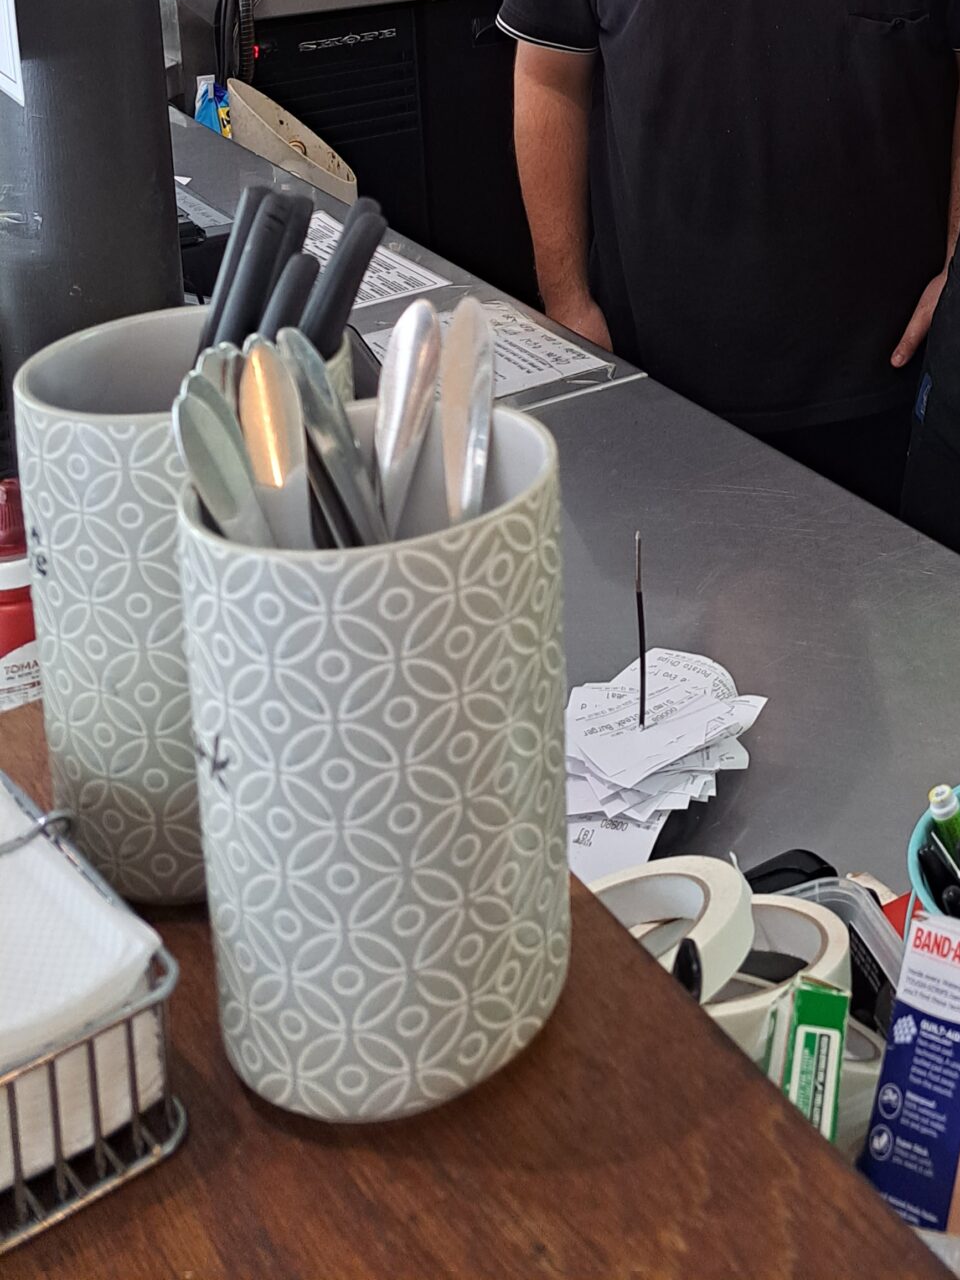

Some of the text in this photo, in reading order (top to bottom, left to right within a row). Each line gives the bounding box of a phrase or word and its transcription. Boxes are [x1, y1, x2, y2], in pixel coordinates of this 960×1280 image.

[299, 28, 397, 52] SKOPE
[3, 660, 39, 675] TOMA
[657, 655, 711, 678] Potato Chips
[583, 723, 613, 737] Burger
